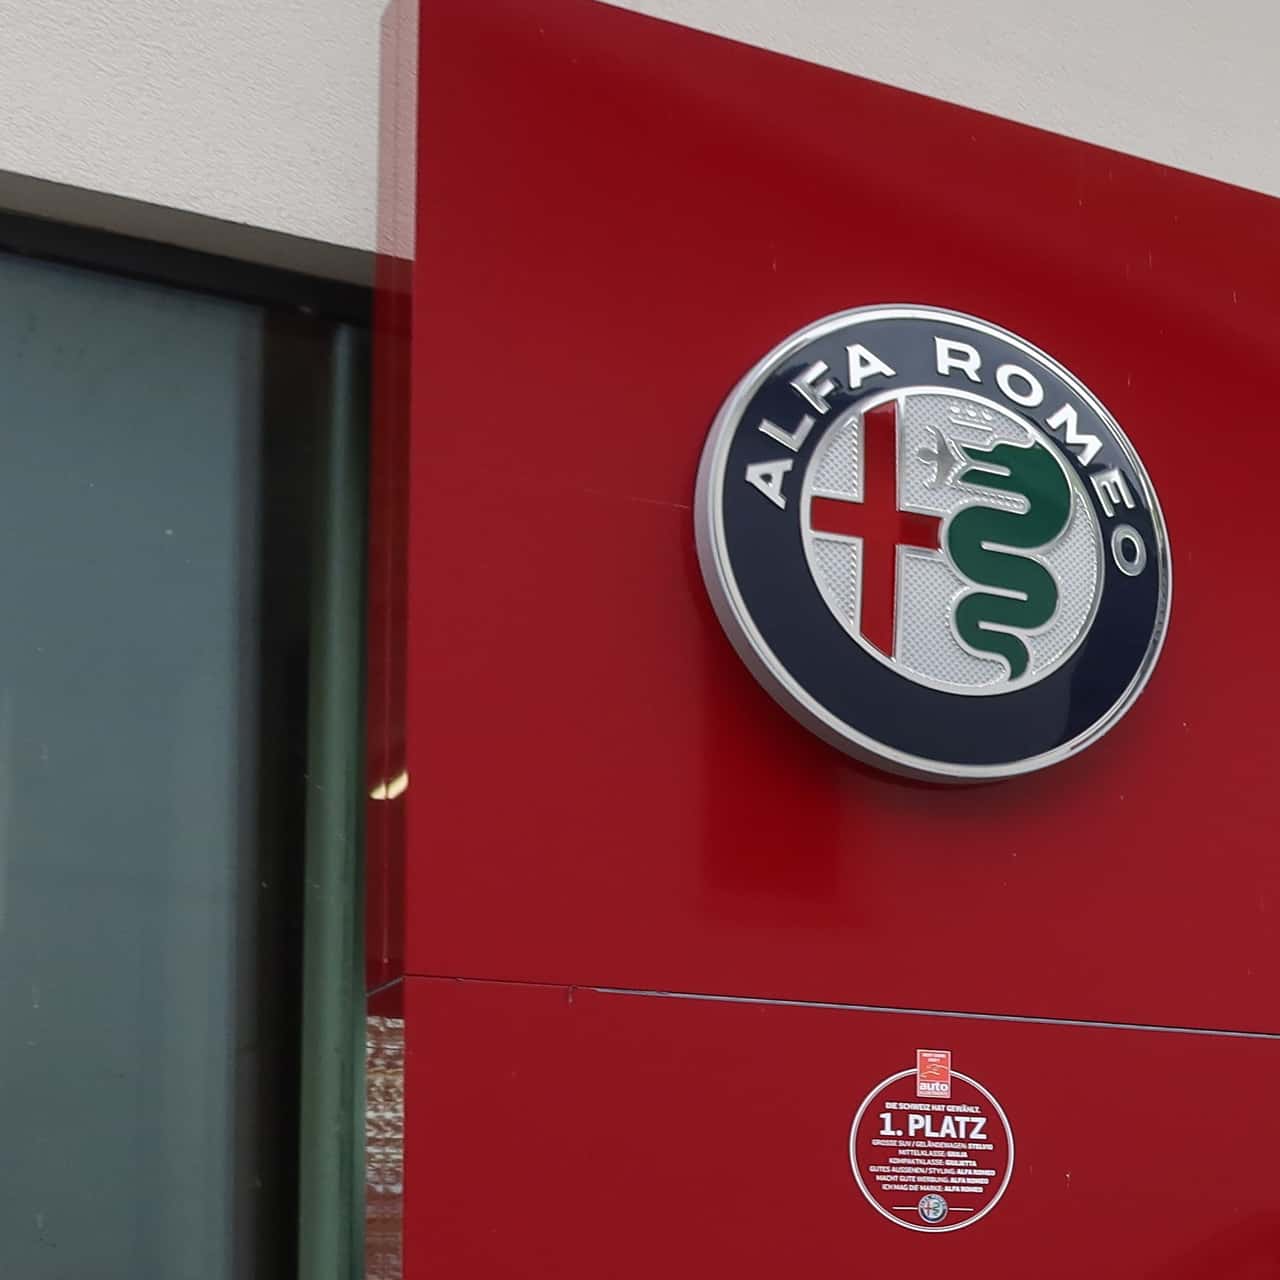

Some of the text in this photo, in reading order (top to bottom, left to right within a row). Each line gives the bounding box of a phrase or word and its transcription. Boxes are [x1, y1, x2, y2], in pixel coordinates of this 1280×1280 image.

[745, 335, 1147, 577] ALFA ROMEO
[919, 1082, 949, 1091] auto
[879, 1112, 988, 1140] 1. PLATZ
